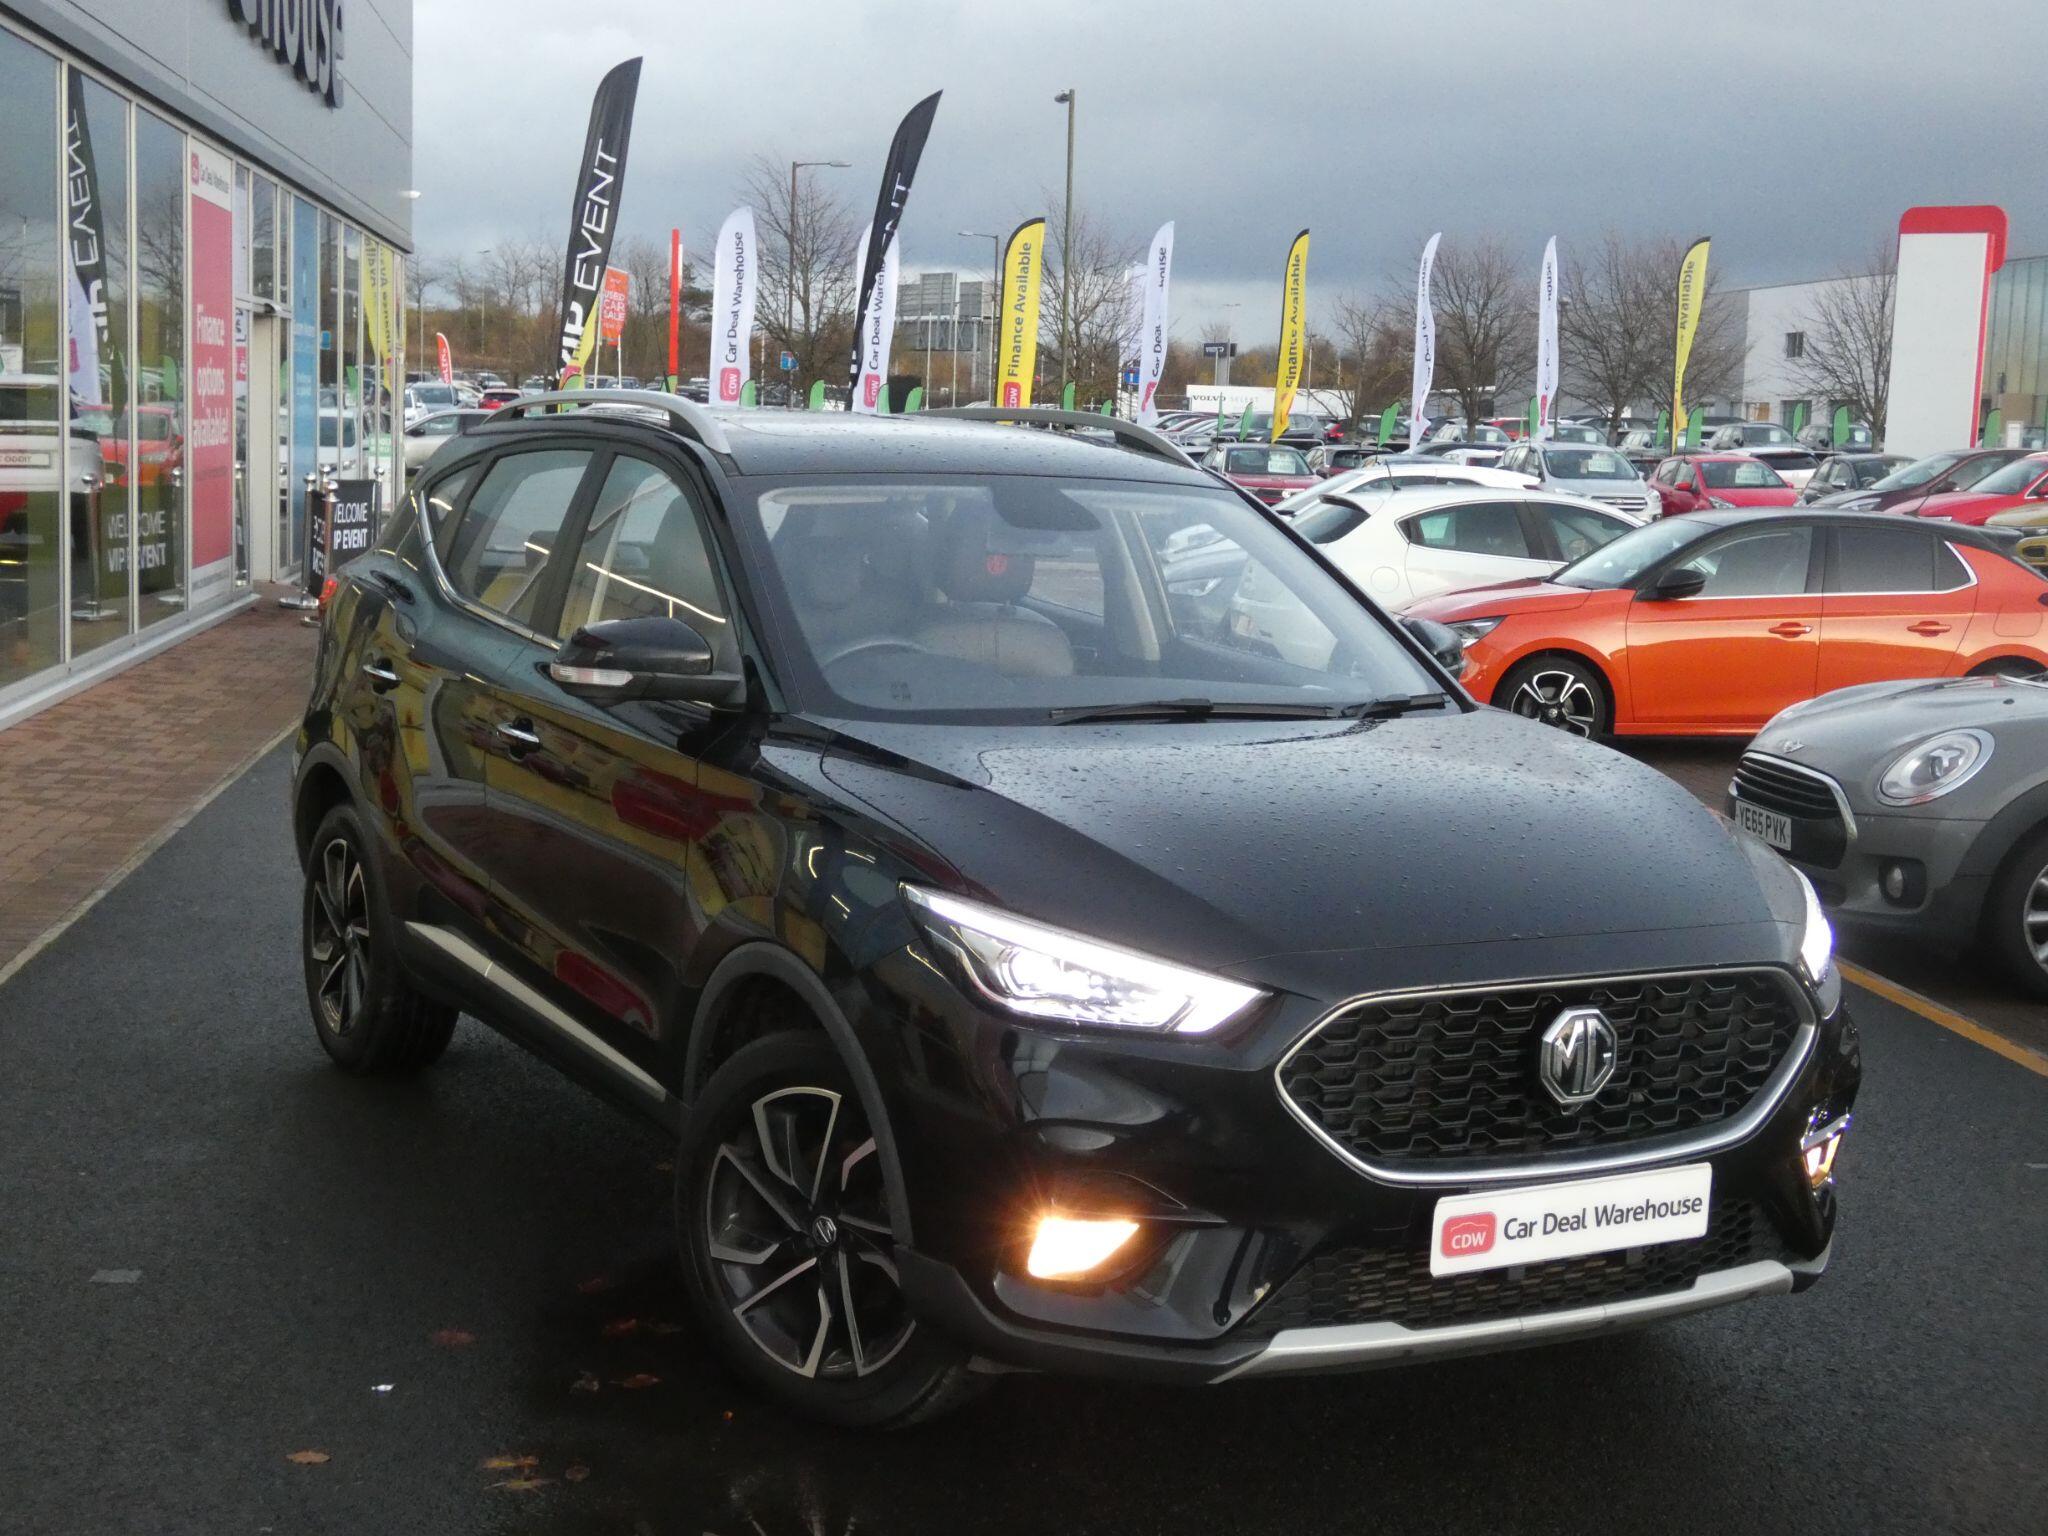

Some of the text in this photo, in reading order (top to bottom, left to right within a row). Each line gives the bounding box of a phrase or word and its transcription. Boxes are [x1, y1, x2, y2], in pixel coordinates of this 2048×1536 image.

[573, 138, 617, 291] EVENT
[732, 231, 744, 307] Warehouse
[1015, 241, 1032, 313] Available
[727, 310, 740, 340] Deal
[870, 320, 881, 347] Deal
[1007, 316, 1024, 378] Finance
[726, 343, 738, 364] Car
[869, 349, 879, 371] Car
[333, 528, 368, 550] IP EVENT
[1552, 1017, 1613, 1095] MG
[1451, 1196, 1704, 1250] CDW Car Deal Warehouse
